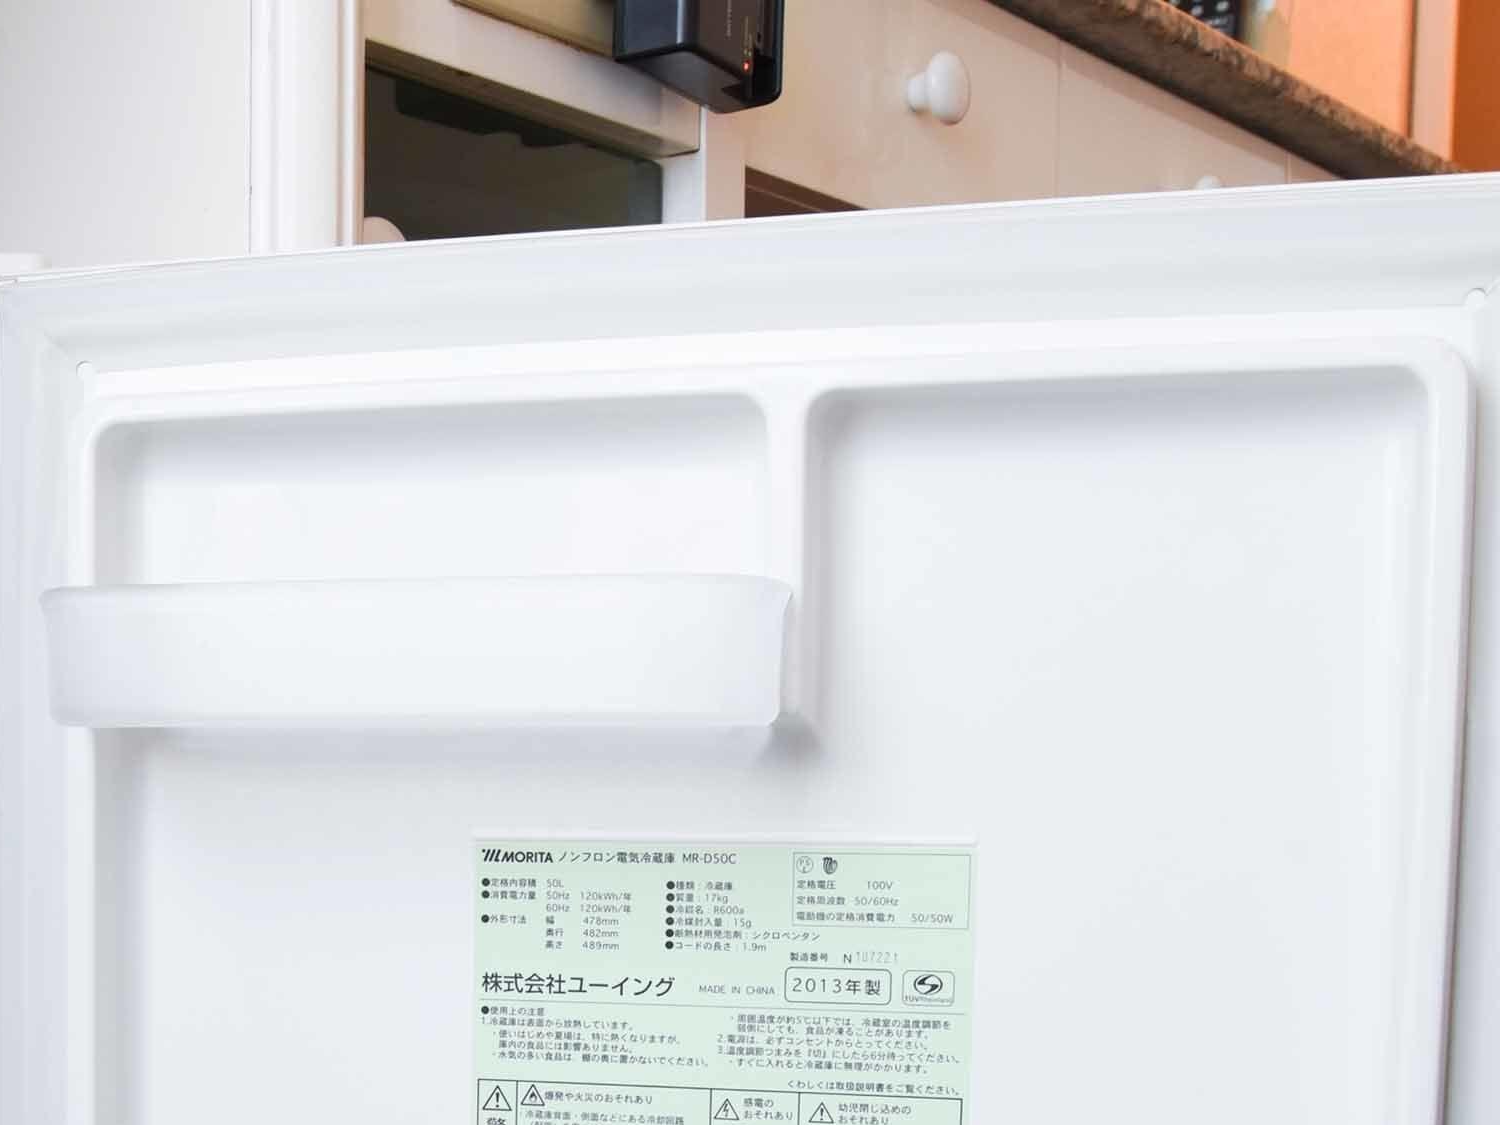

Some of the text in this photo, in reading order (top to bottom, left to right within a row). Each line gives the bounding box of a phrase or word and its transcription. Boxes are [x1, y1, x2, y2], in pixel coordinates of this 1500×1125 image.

[501, 851, 737, 865] MORITA ノンフロン電気冷蔵庫 MR-D50C
[546, 879, 564, 888] 50L
[796, 880, 893, 891] 定格電圧 100V
[546, 891, 570, 901] 50Hz
[796, 896, 900, 906] 定格周波数 50/60Hz
[545, 903, 570, 913] 60Hz
[490, 915, 527, 925] 外形寸法
[582, 917, 619, 926] 478mm
[911, 913, 954, 924] 50/50W
[582, 928, 619, 938] 482mm
[582, 941, 620, 951] 489mm
[789, 952, 829, 962] 製造番号
[481, 971, 676, 998] 株式会社ユーイング
[792, 977, 882, 997] 2013年製
[699, 985, 776, 996] MADE IN CHINA
